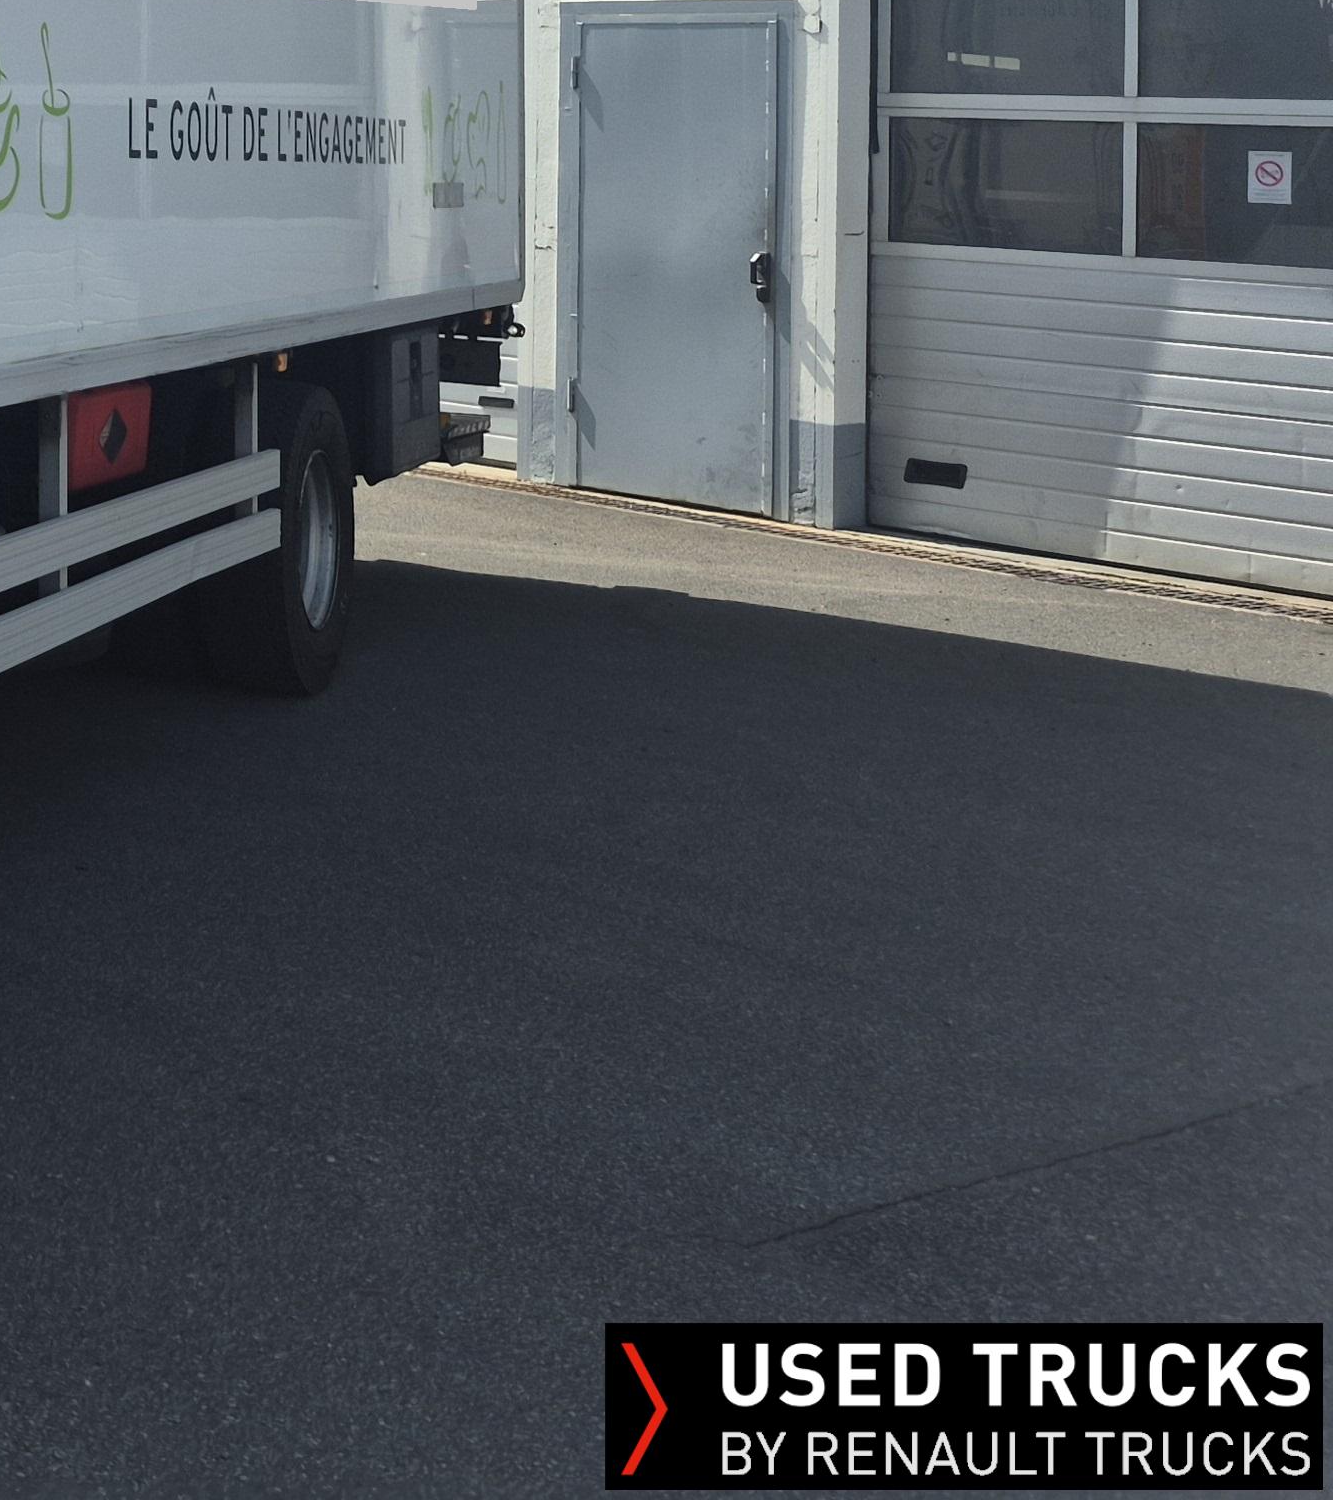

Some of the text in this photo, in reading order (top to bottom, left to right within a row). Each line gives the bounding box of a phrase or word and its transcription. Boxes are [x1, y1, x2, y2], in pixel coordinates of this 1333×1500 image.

[128, 87, 407, 164] LE GOÛT DE L'ENGAGEMENT
